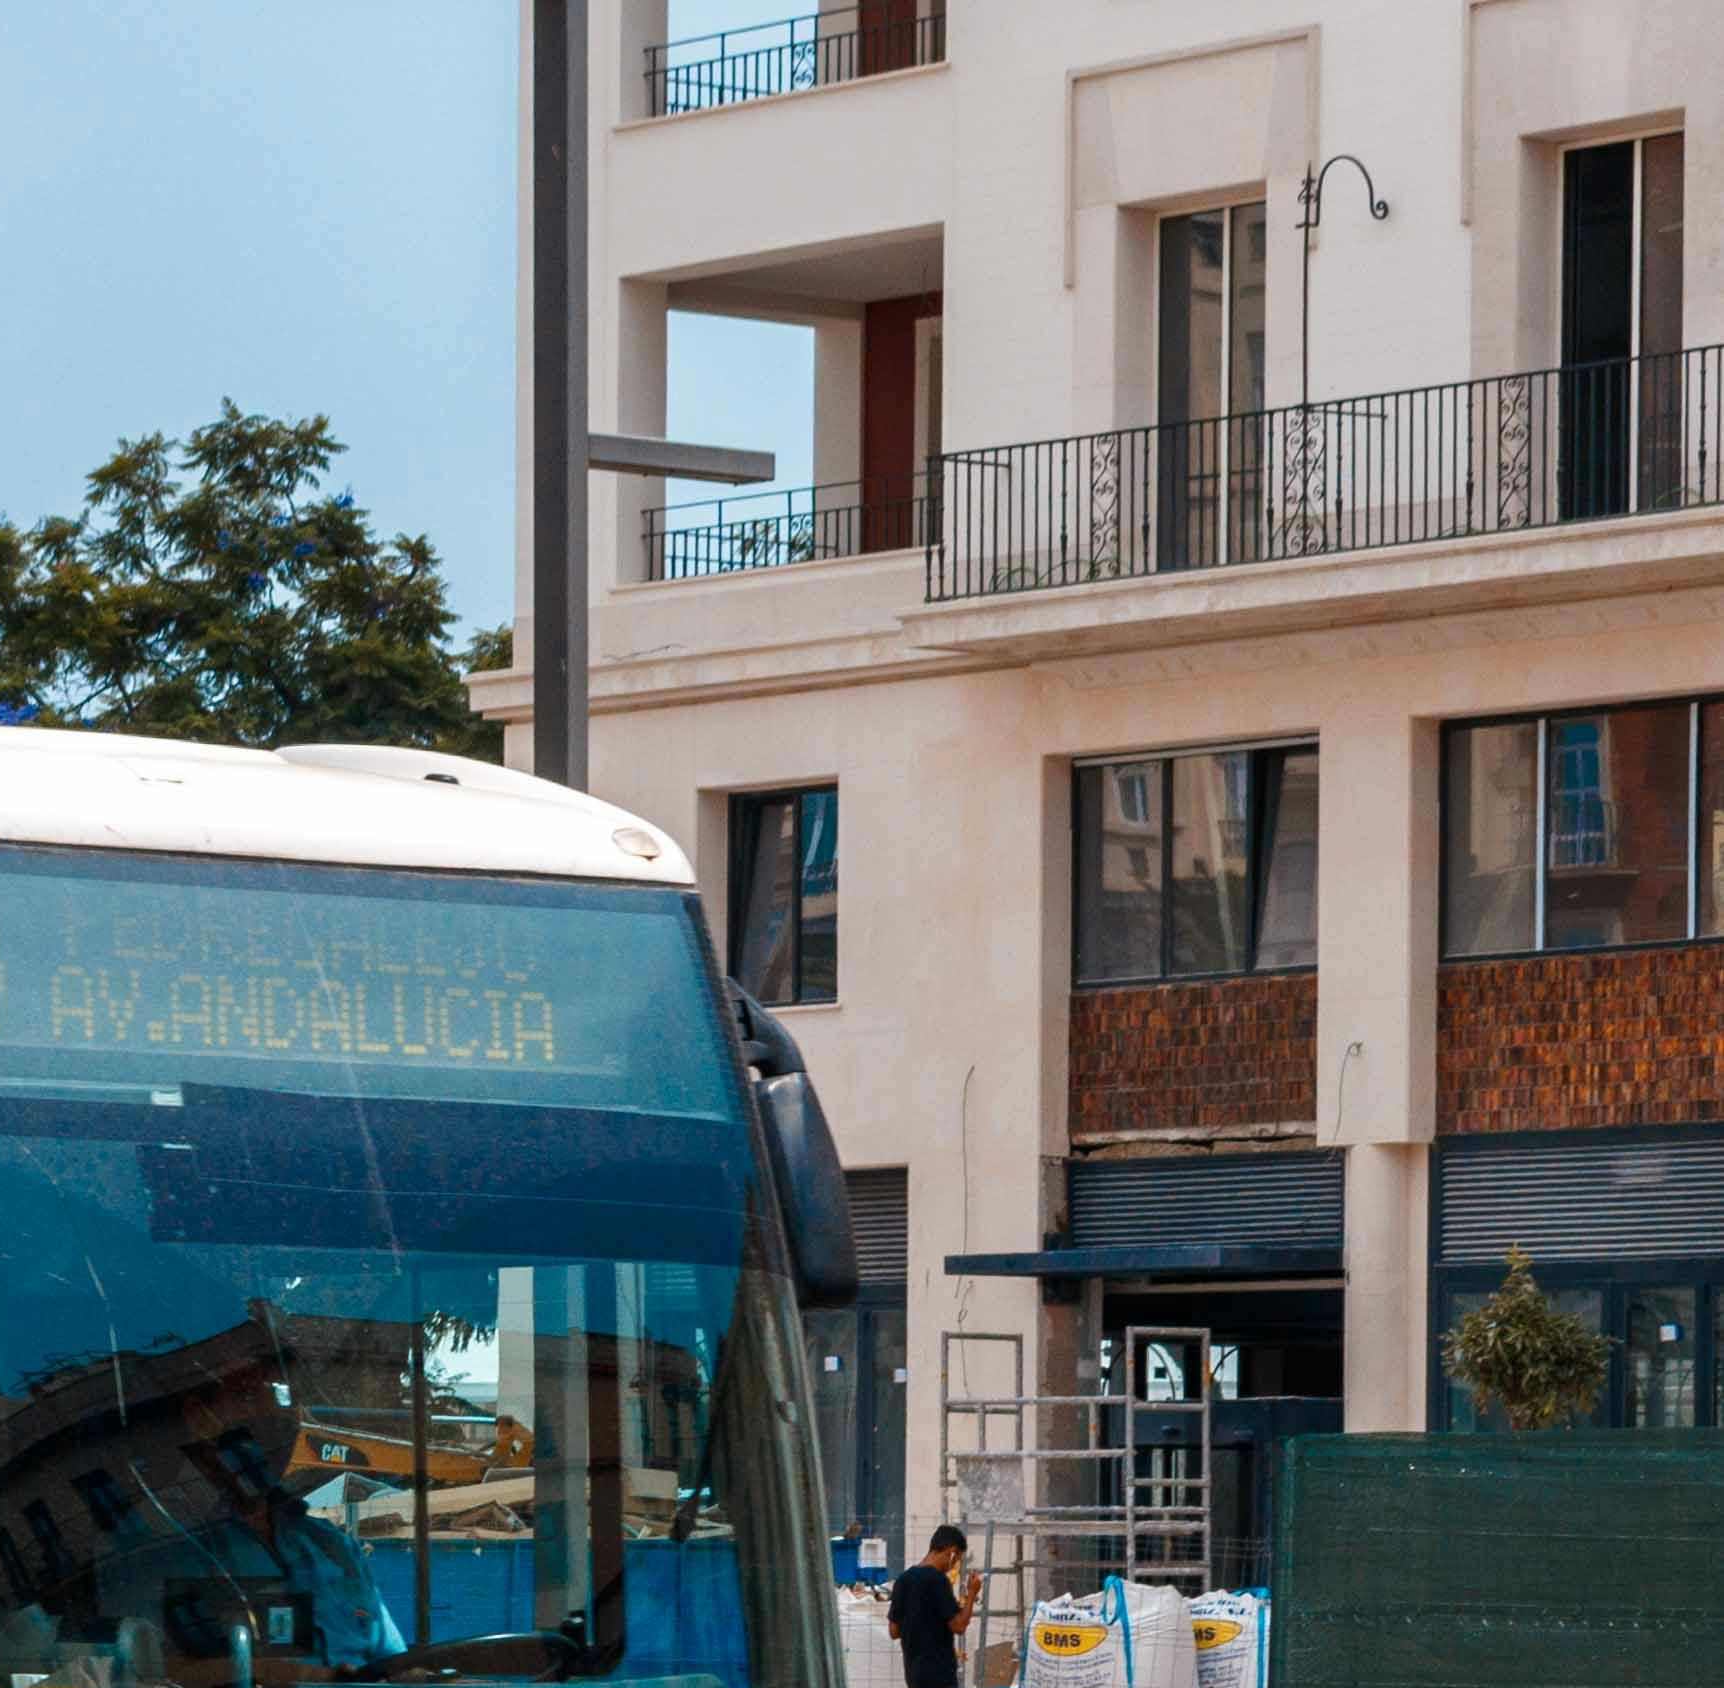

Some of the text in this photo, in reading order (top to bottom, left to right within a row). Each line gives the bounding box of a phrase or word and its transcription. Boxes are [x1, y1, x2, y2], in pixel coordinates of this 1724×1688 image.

[321, 1443, 350, 1463] CAT
[1042, 1630, 1082, 1649] BMS
[1194, 1626, 1216, 1643] MS
